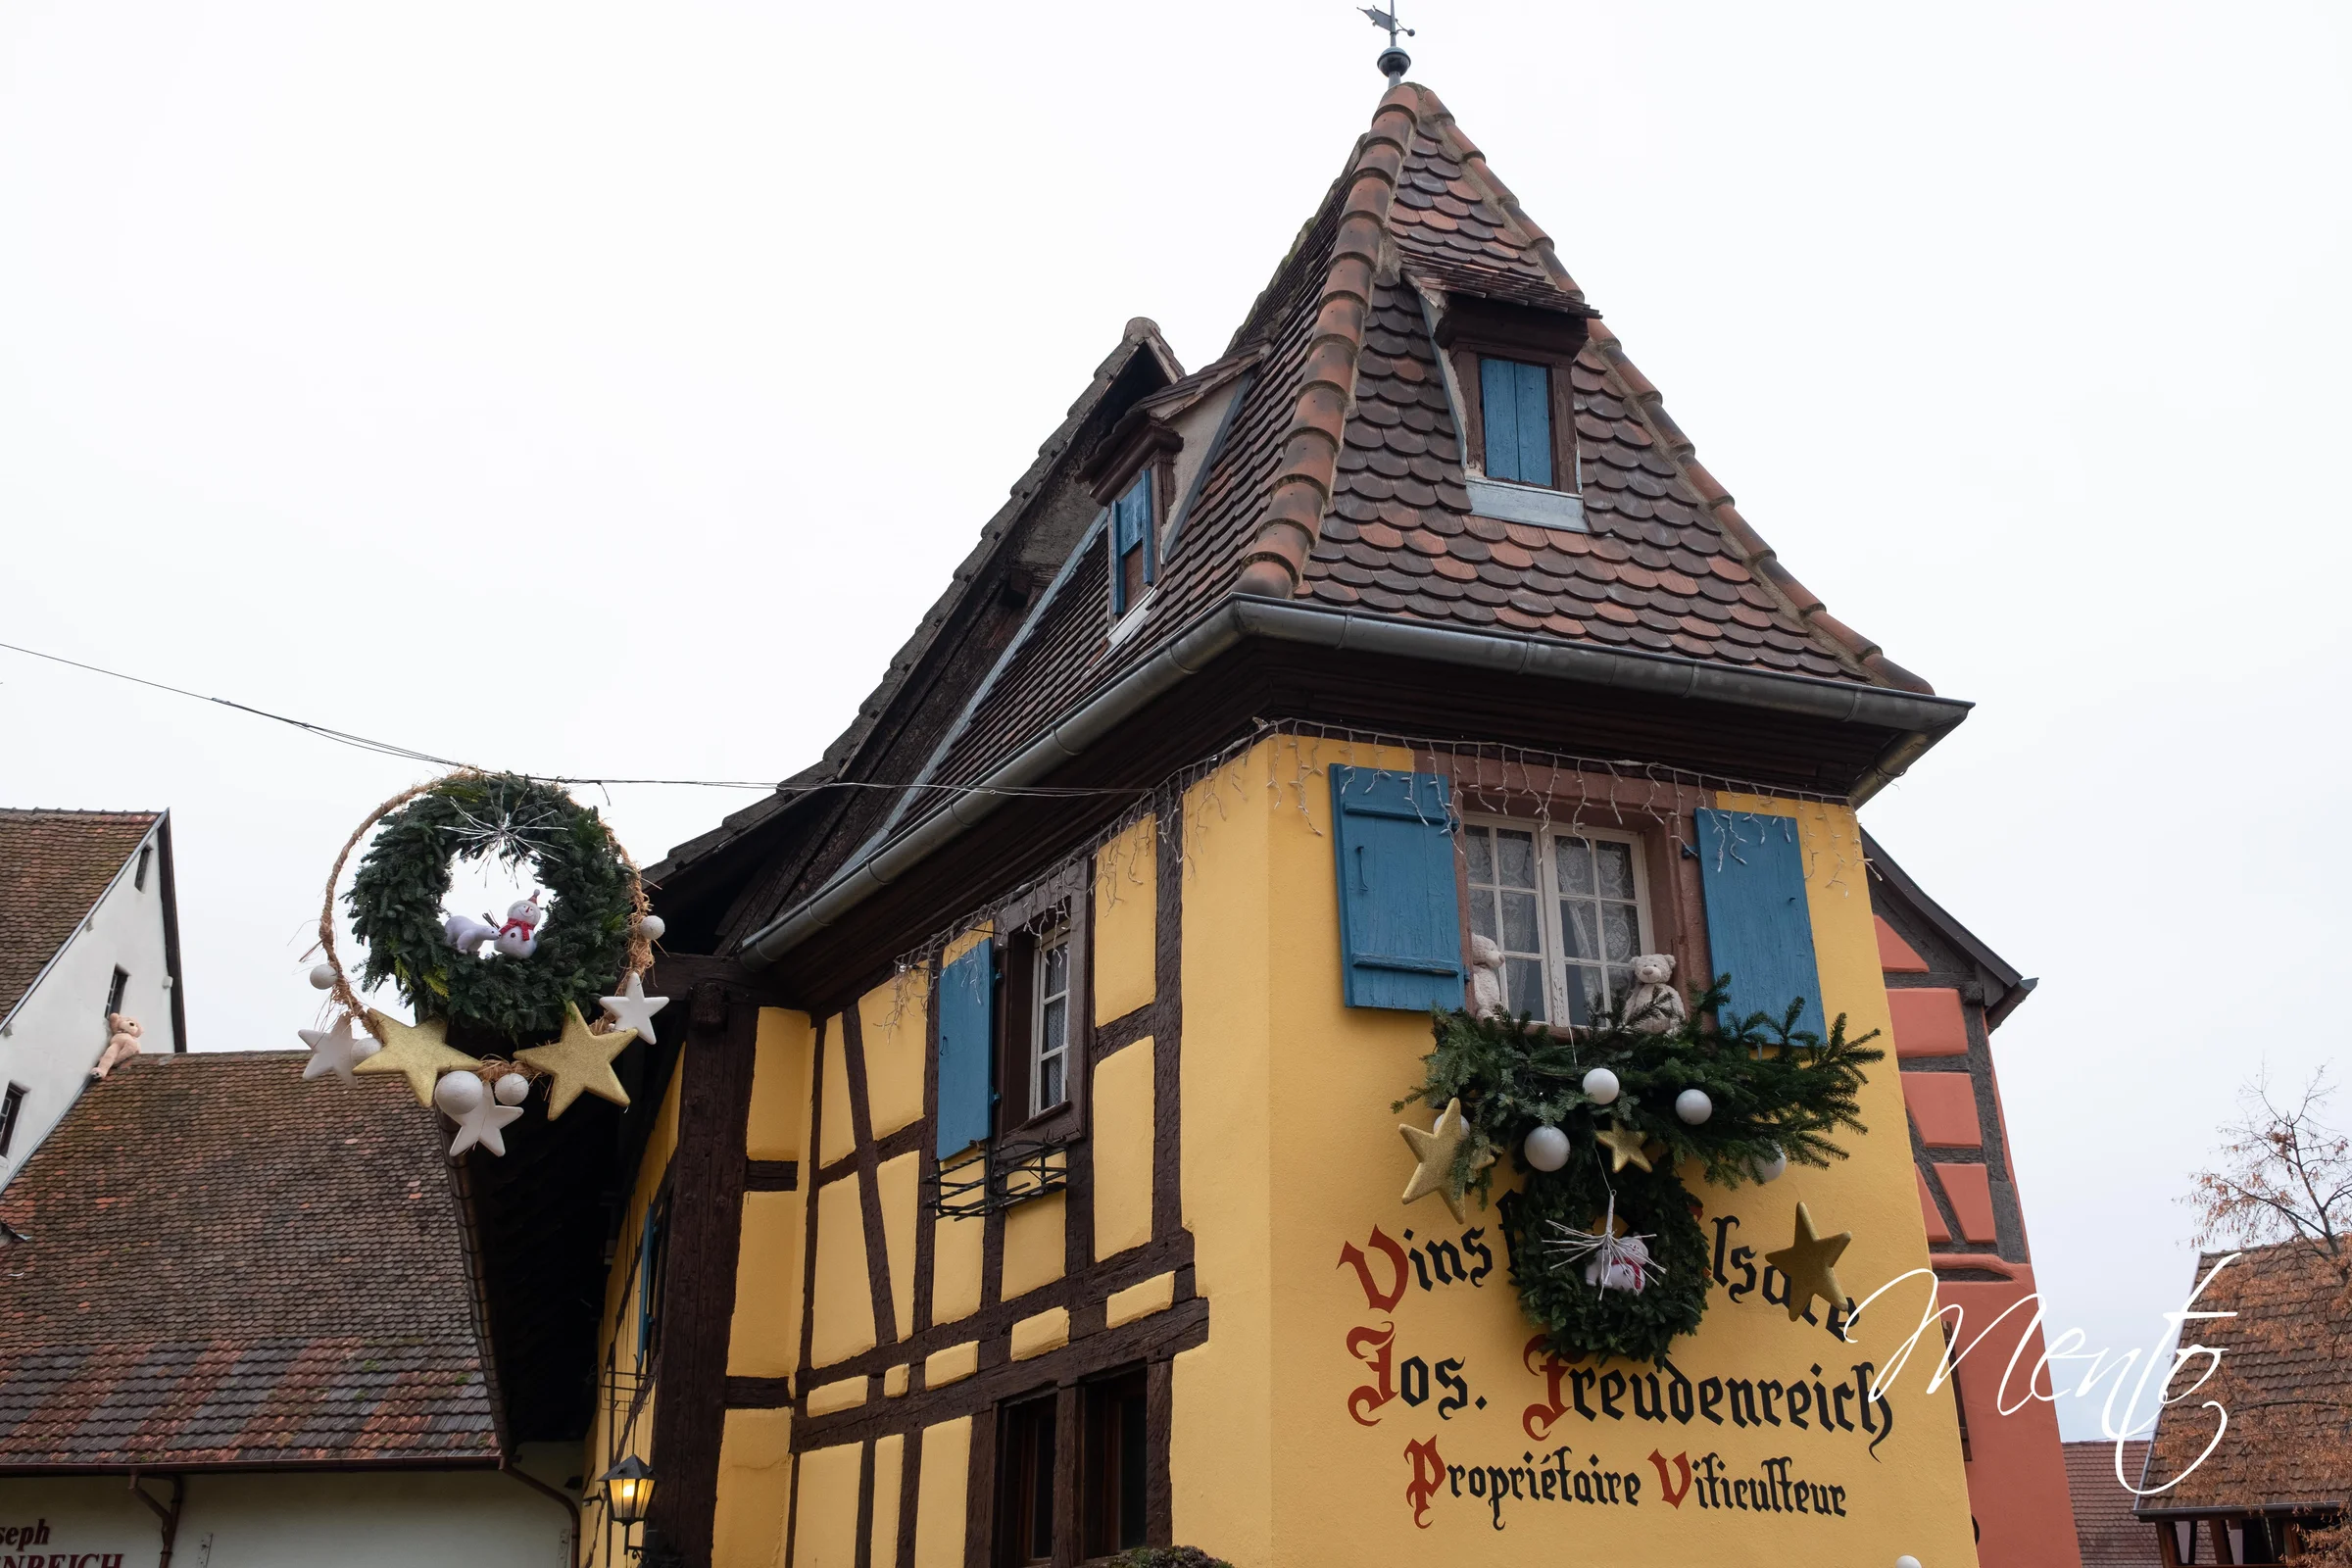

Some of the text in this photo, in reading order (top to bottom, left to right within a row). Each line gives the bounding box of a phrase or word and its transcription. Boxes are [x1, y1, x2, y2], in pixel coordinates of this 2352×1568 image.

[1337, 1224, 1493, 1313] Vins
[1347, 1321, 1488, 1427] Jos.
[1403, 1435, 1847, 1531] Propriétaire Viticulteur
